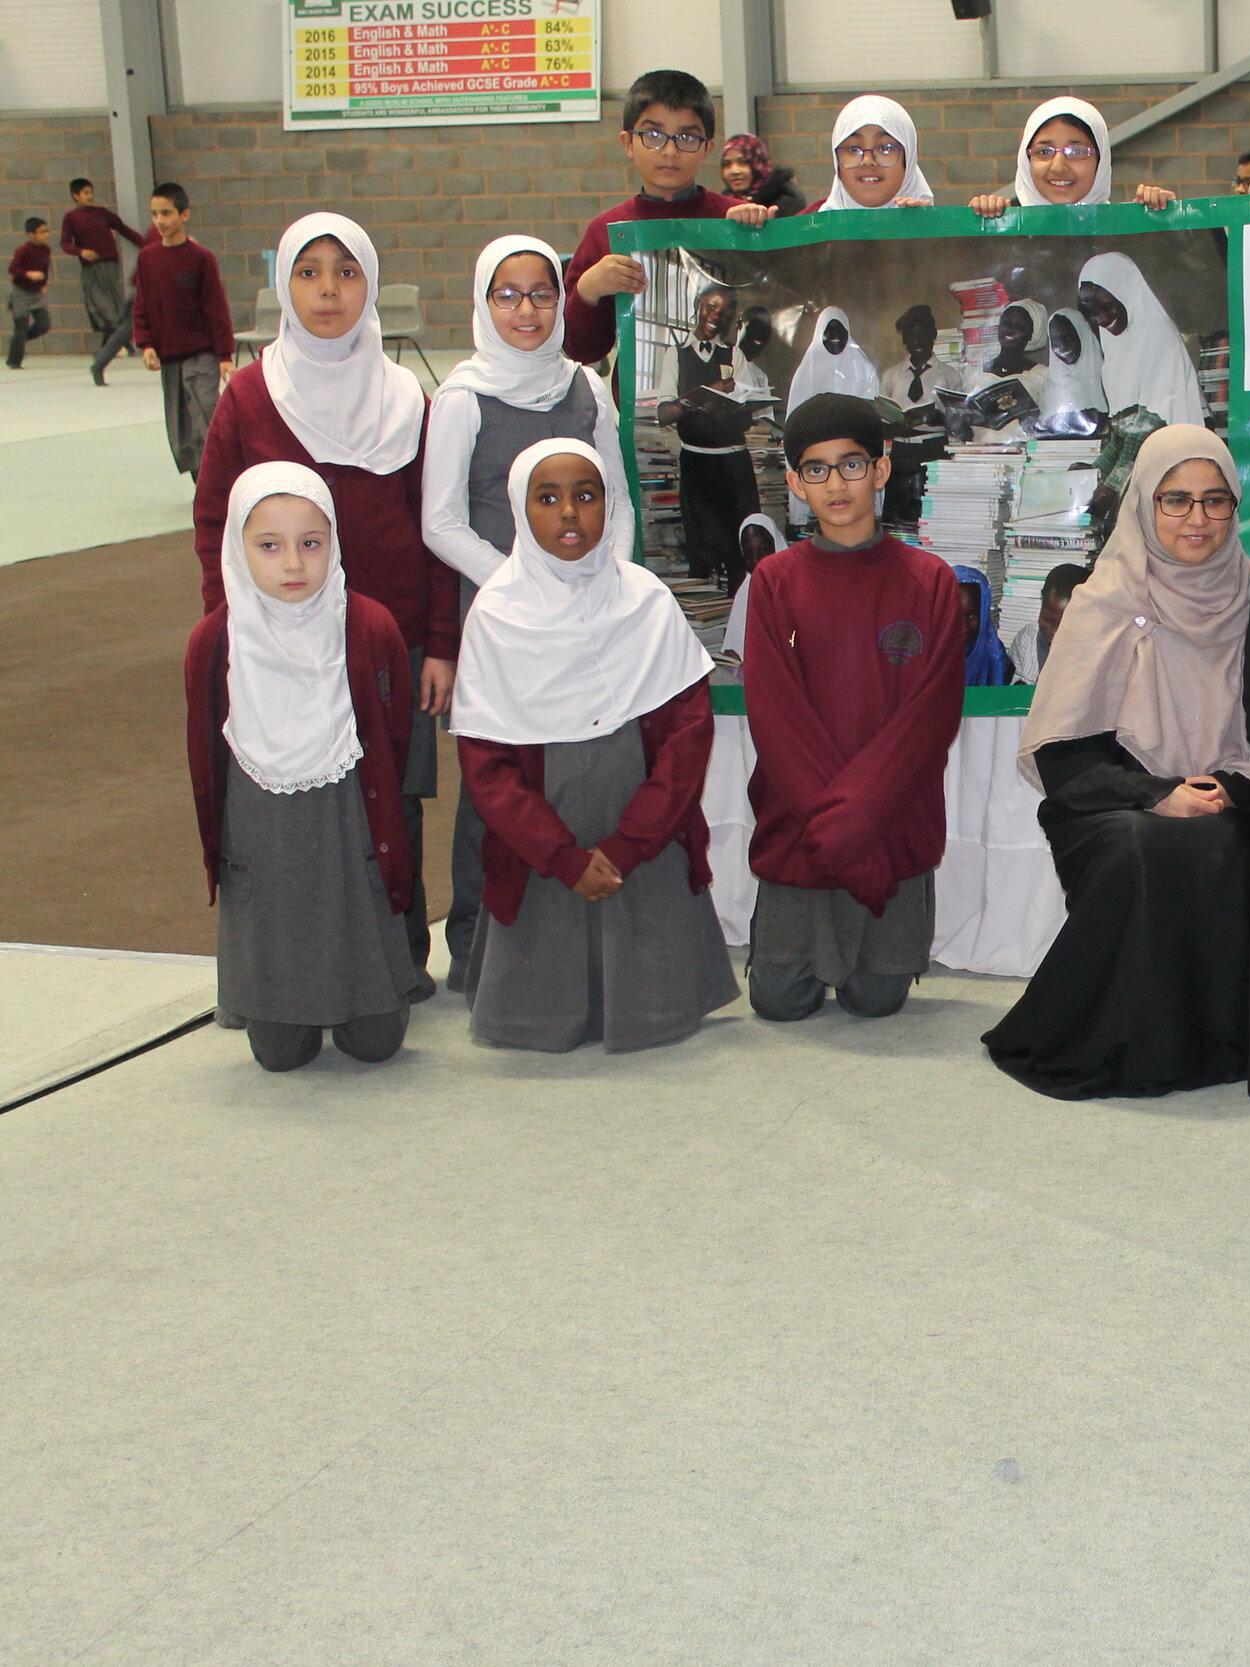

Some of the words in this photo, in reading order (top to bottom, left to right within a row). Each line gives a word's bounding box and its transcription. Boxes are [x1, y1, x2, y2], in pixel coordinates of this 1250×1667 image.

[350, 4, 413, 22] EXAM
[422, 0, 532, 20] SUCCESS
[354, 27, 400, 42] English
[404, 26, 414, 38] &
[417, 24, 448, 37] Math
[501, 24, 511, 35] C
[545, 22, 574, 34] 84%
[305, 30, 336, 43] 2016
[354, 45, 400, 60] English
[404, 44, 414, 56] &
[417, 42, 448, 55] Math
[501, 42, 511, 53] C
[545, 40, 574, 52] 63%
[305, 48, 336, 61] 2015
[354, 63, 400, 78] English
[405, 62, 414, 74] &
[418, 60, 449, 73] Math
[501, 59, 511, 70] C
[545, 58, 574, 71] 76%
[306, 66, 336, 79] 2014
[306, 84, 336, 97] 2013
[354, 82, 378, 94] 95%
[381, 81, 409, 94] Boys
[412, 79, 464, 92] Achieved
[467, 78, 500, 90] GCSE
[503, 77, 537, 89] Grade
[561, 75, 571, 87] C
